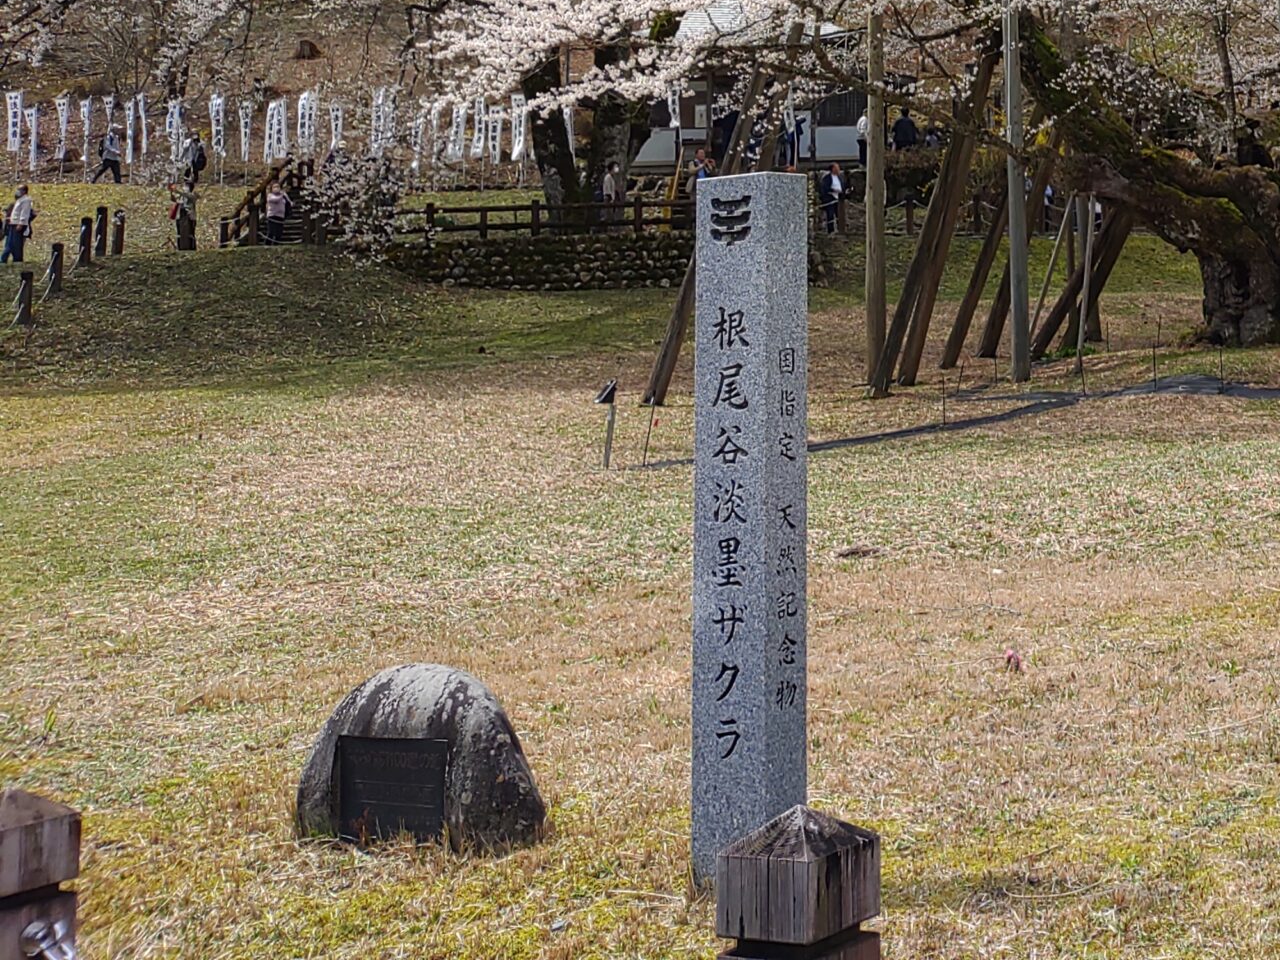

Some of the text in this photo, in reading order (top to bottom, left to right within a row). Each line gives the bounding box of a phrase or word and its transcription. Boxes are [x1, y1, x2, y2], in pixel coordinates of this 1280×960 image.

[711, 307, 751, 760] 根尾谷淡墨ザクラ
[776, 347, 798, 712] 国指定 天然記念物
